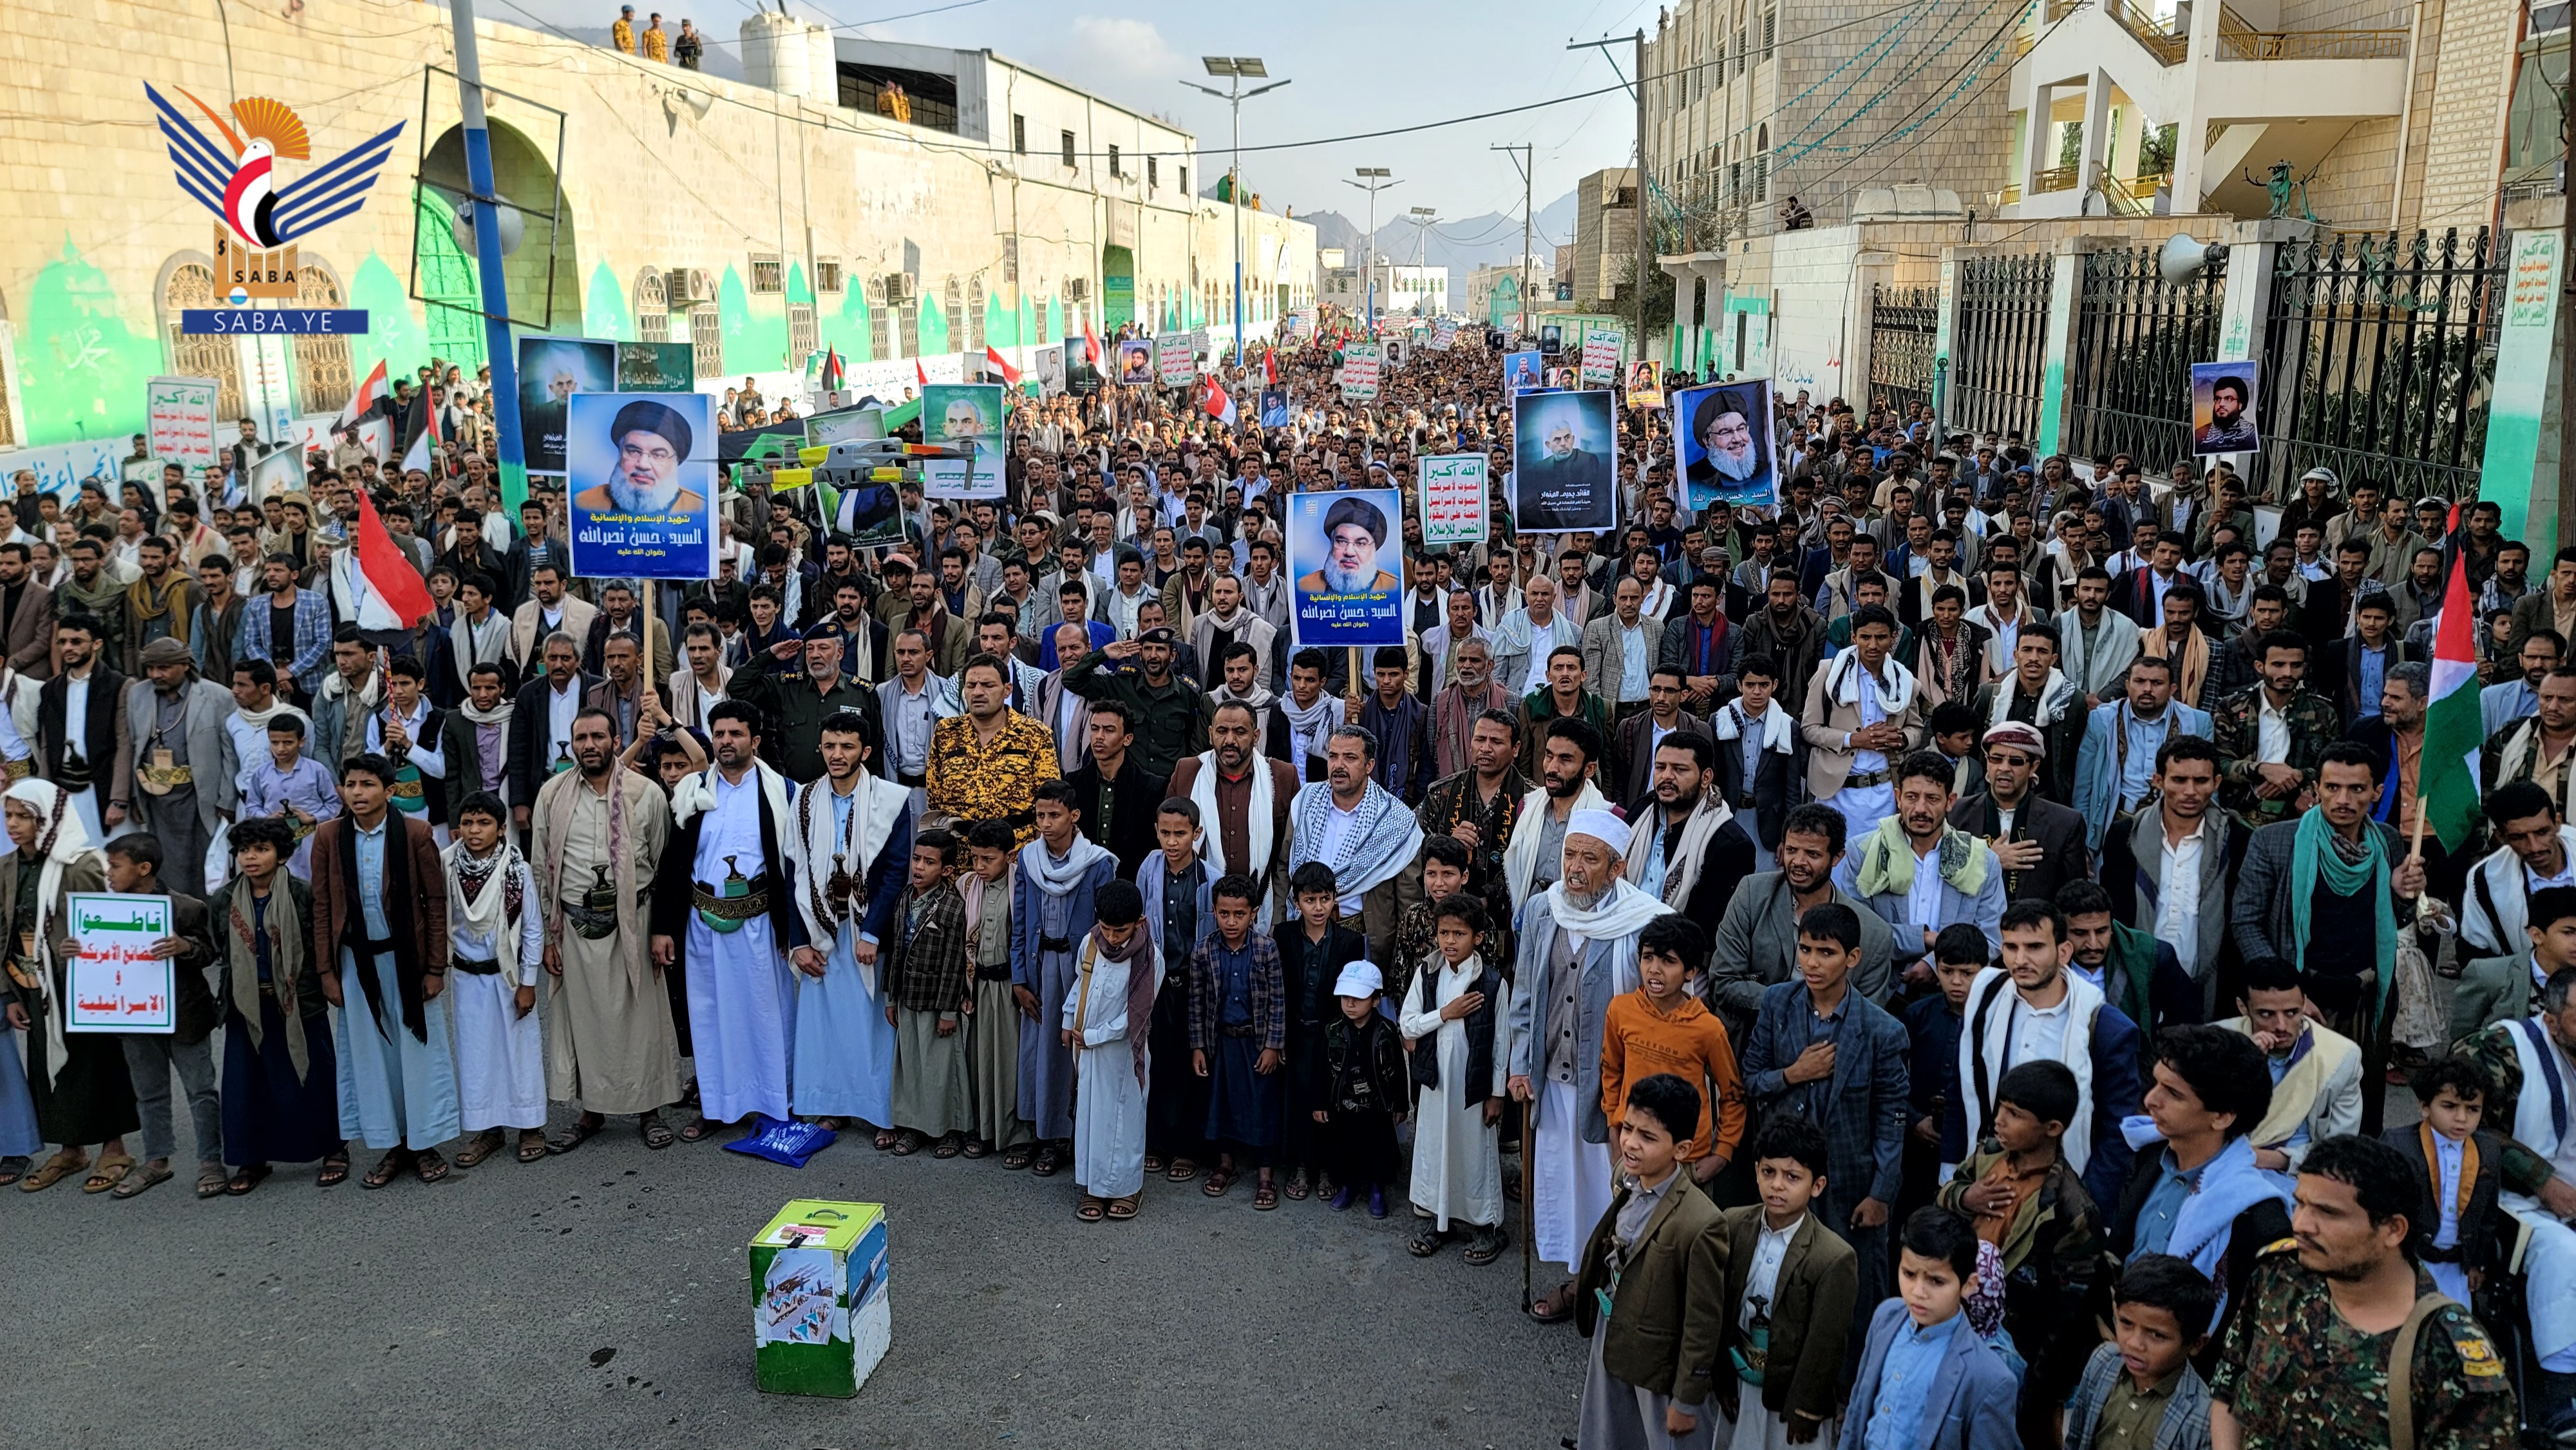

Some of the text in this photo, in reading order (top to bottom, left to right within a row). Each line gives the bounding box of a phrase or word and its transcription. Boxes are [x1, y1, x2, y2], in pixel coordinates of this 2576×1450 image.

[1587, 332, 1620, 343] الله أكبر
[1347, 346, 1379, 358] الله أكبر
[153, 388, 210, 407] الله أكبر
[1428, 461, 1480, 481] الله أكبر
[1428, 479, 1480, 493] الموت لأمريكا
[1693, 488, 1705, 502] الله
[1708, 492, 1723, 502] نصر
[1726, 493, 1744, 502] حسن
[1752, 488, 1770, 500] السيد
[1428, 495, 1481, 508] الموت لإسرائيل
[591, 513, 690, 524] شهيد الإسلام والإنسانية
[1428, 510, 1481, 521] اللعنة على اليهود
[629, 526, 661, 546] حسن
[669, 528, 703, 547] السيد
[1429, 522, 1481, 539] النصر للإسلام
[1310, 593, 1387, 602] شهيد الإسلام والإنسانية
[1340, 604, 1365, 620] حسن
[1371, 604, 1397, 619] السيد
[78, 908, 162, 935] قاطعوا
[115, 970, 122, 986] و
[77, 993, 165, 1016] الإسرائيلية
